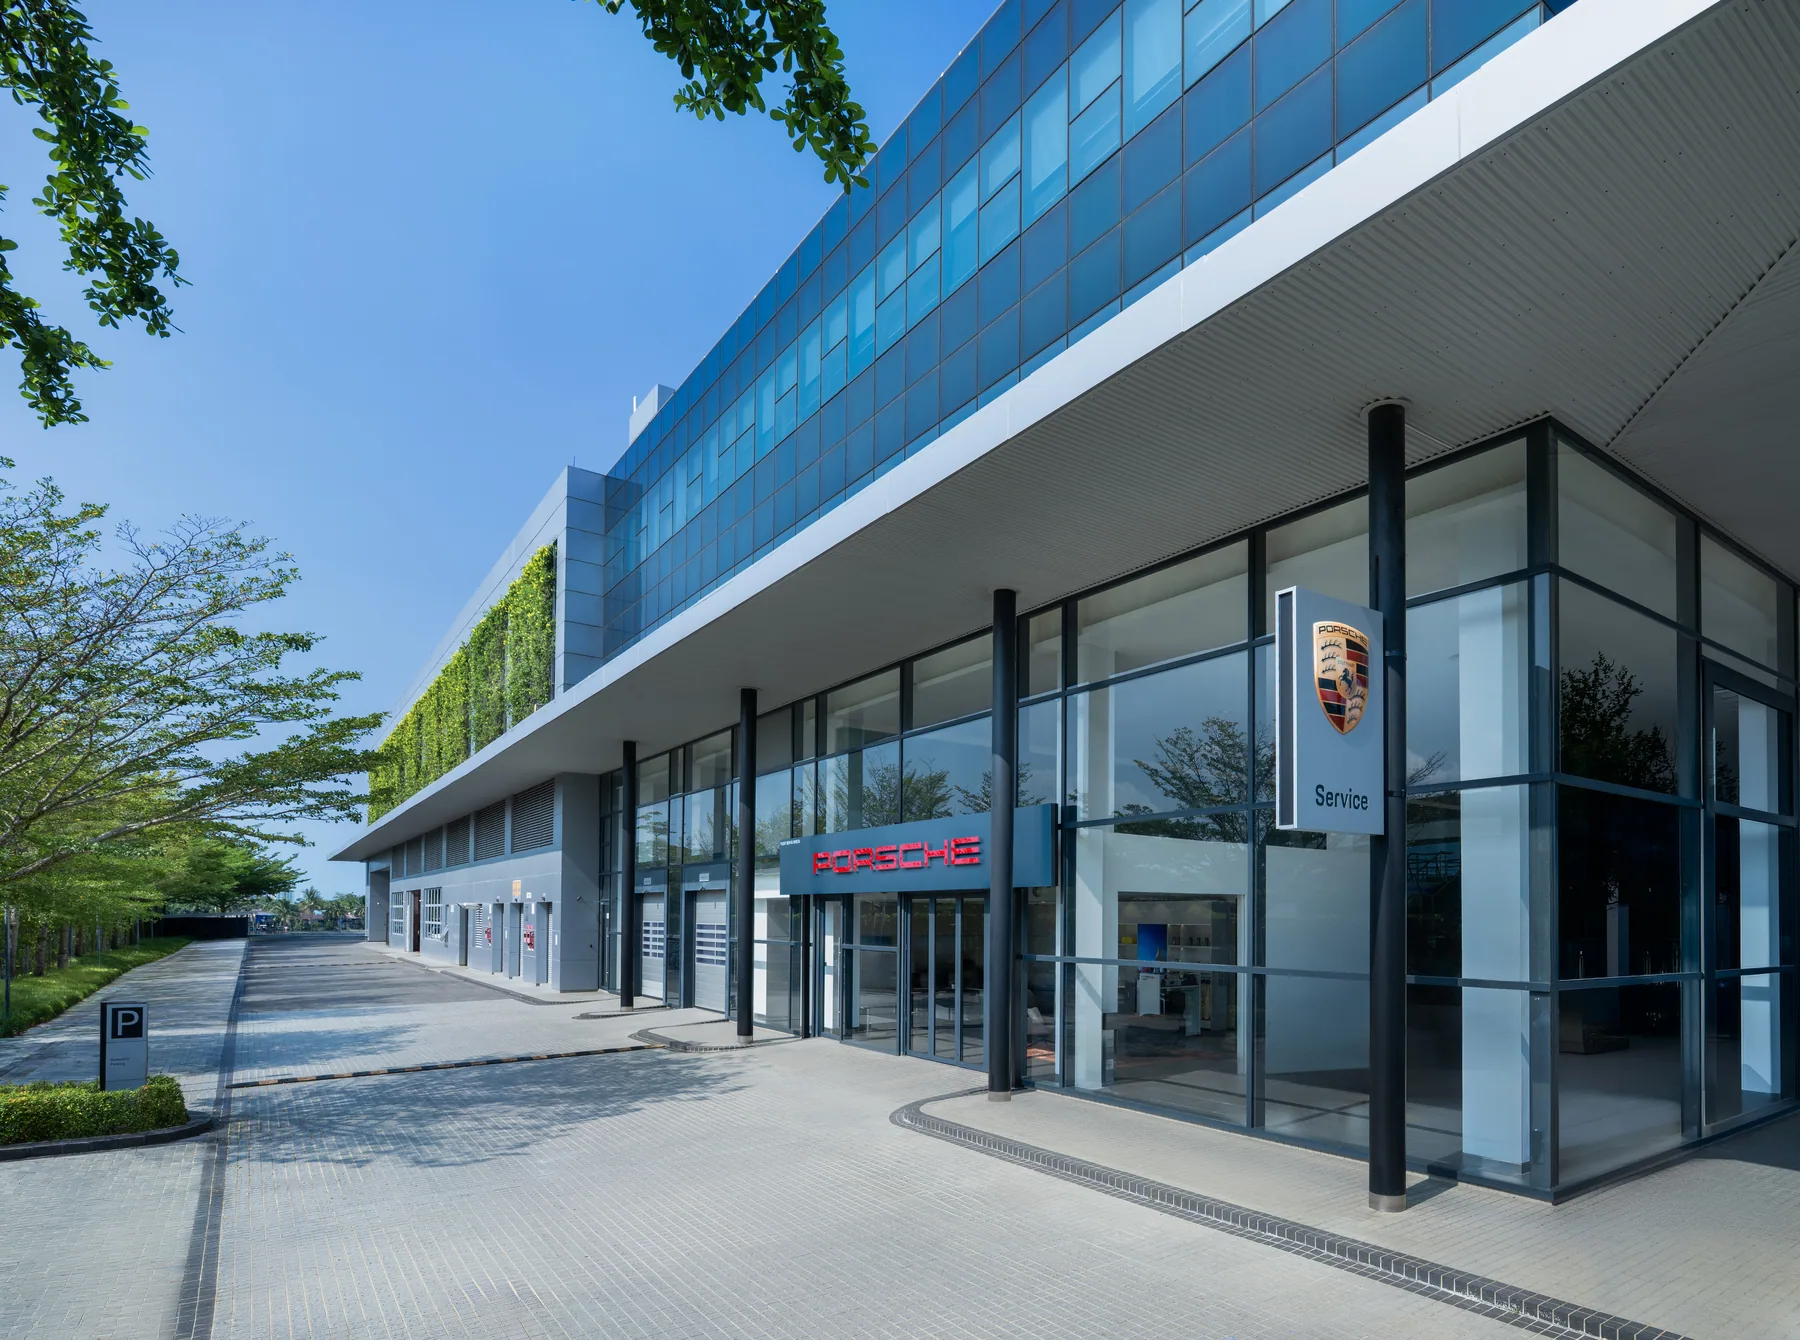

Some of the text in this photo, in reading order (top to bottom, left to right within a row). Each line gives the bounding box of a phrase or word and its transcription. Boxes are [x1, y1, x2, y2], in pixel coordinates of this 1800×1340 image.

[1318, 624, 1368, 647] PORSCHE
[1315, 783, 1369, 811] Service
[814, 836, 982, 876] PORSCHE
[117, 1010, 140, 1036] P
